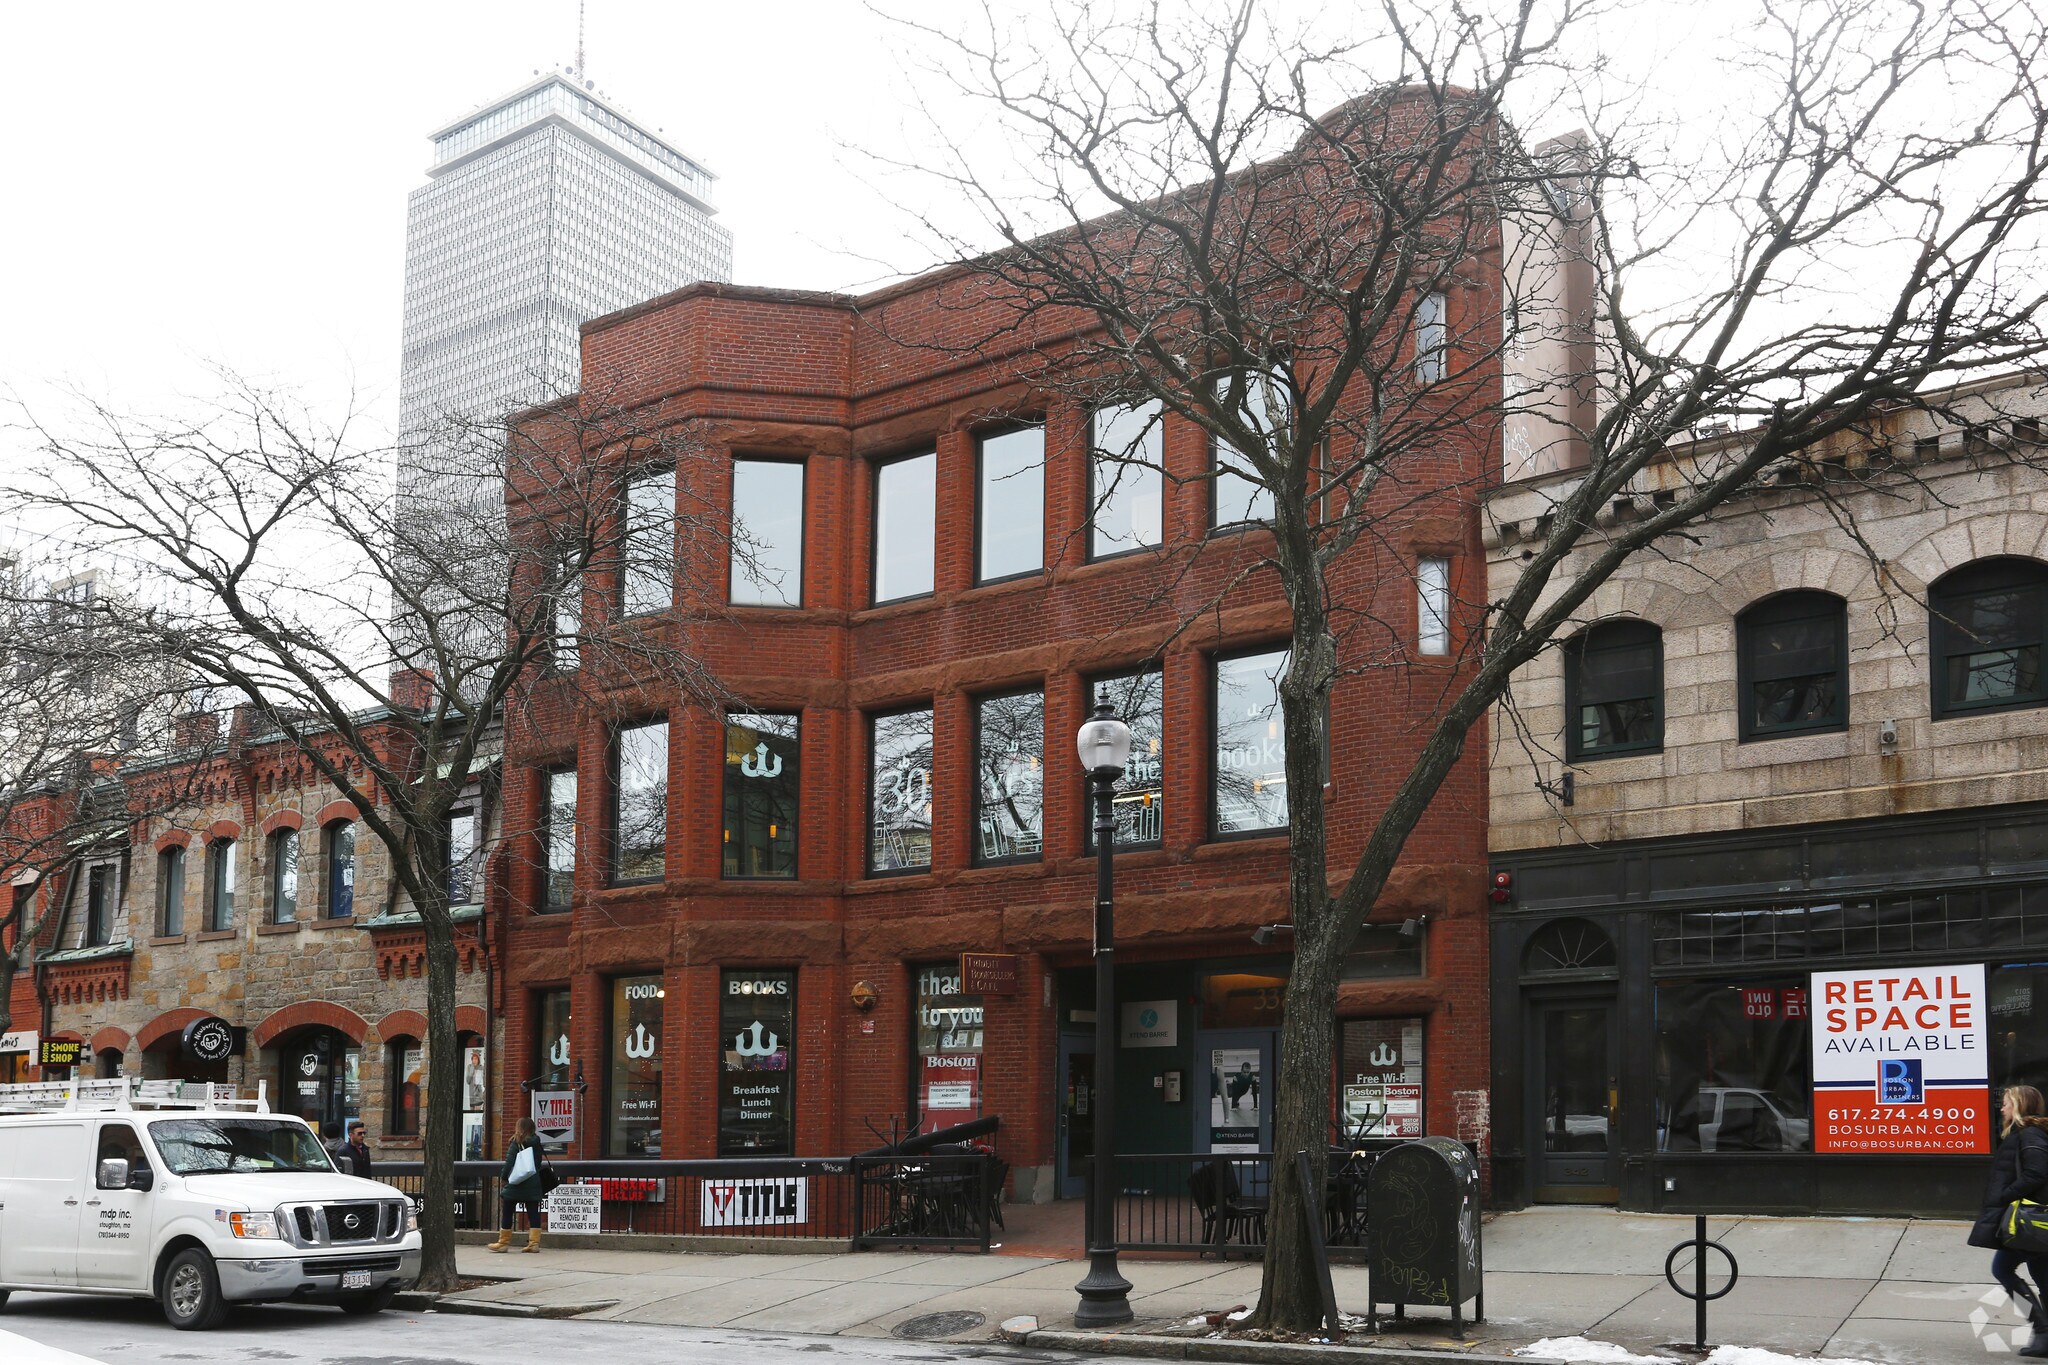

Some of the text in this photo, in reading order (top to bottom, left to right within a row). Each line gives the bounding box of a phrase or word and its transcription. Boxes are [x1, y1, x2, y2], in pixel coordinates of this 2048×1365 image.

[879, 767, 927, 813] 30
[1125, 751, 1161, 782] the
[729, 980, 788, 995] BOOKS
[919, 970, 960, 995] than
[625, 984, 658, 1000] FOOD
[1825, 976, 1971, 1005] RETAIL
[920, 1003, 984, 1034] to you
[1826, 1003, 1973, 1033] SPACE
[215, 1023, 230, 1042] Comics
[51, 1043, 80, 1052] SMOKE
[1825, 1034, 1976, 1054] AVAILABLE
[50, 1054, 73, 1062] SHOP
[927, 1056, 976, 1068] Boston
[1356, 1073, 1406, 1084] Free Wi-F
[298, 1081, 320, 1089] NEWBURY
[733, 1085, 780, 1095] Breakfast
[1348, 1088, 1382, 1096] Boston
[1385, 1087, 1418, 1096] Boston
[550, 1098, 572, 1116] TITLE
[622, 1100, 656, 1110] Free Wi-Fi
[741, 1098, 771, 1107] Lunch
[740, 1111, 772, 1120] Dinner
[1828, 1108, 1976, 1121] 617.274.4900
[537, 1116, 572, 1128] BOXING CLUB
[1829, 1125, 1975, 1135] BOSURBAN.COM
[1828, 1140, 1975, 1150] INFO@BOSURBAN.COM
[738, 1184, 798, 1218] TITLE
[100, 1209, 132, 1220] mdp inc.
